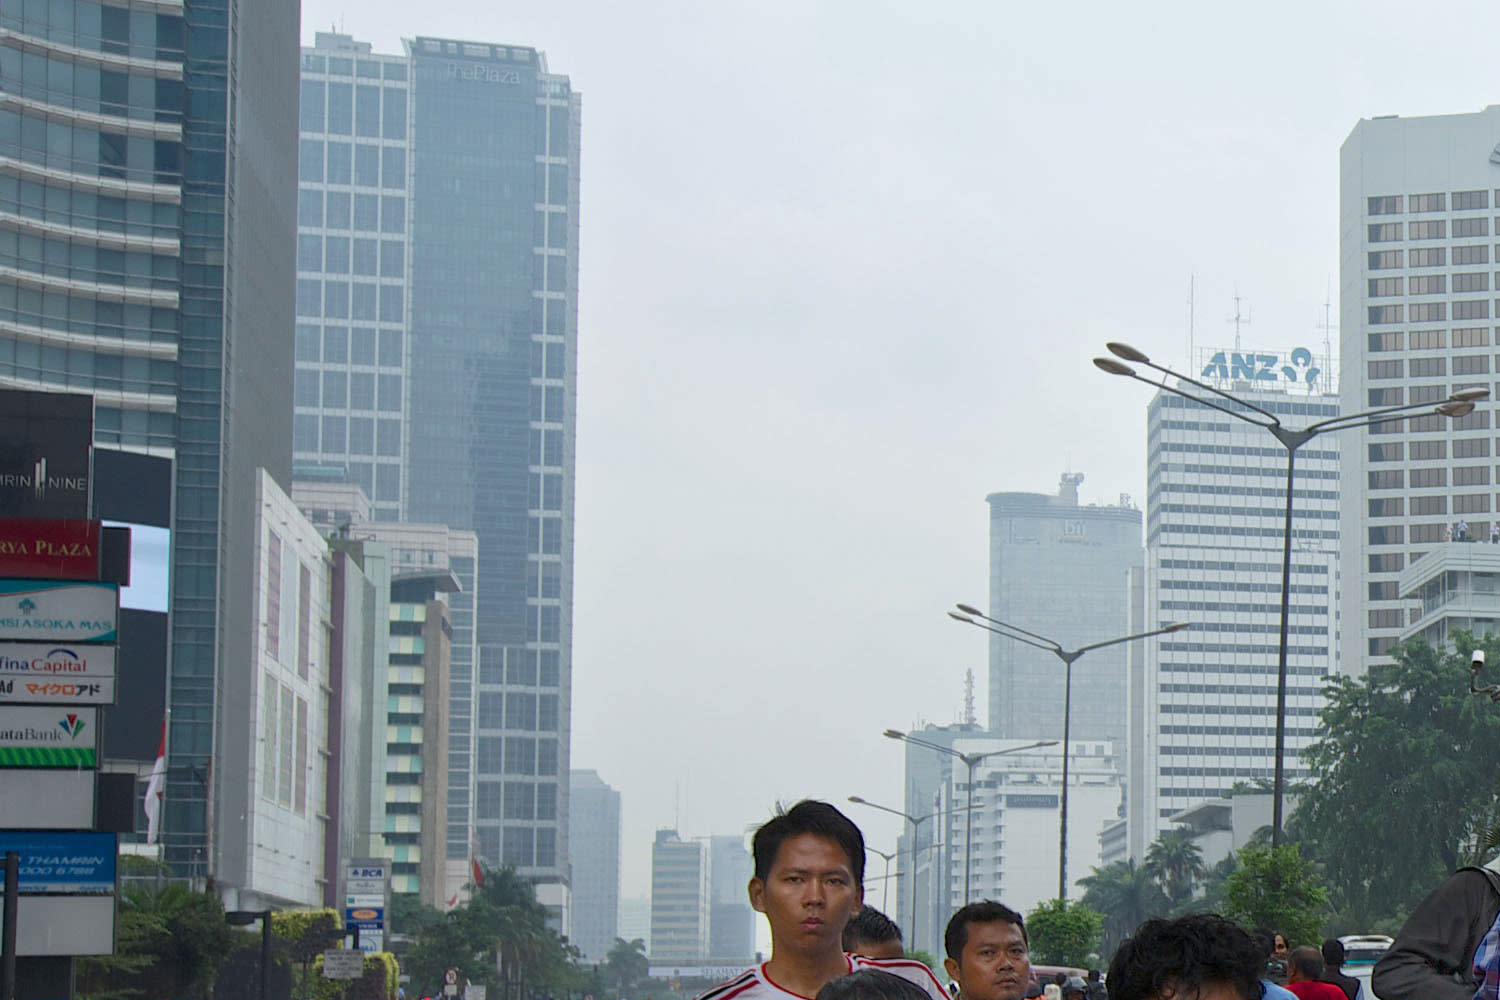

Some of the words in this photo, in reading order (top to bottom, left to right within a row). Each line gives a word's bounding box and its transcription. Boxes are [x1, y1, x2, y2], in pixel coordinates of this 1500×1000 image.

[1201, 352, 1278, 380] ANZ
[48, 477, 87, 490] NINE
[22, 619, 75, 630] ASOKA
[79, 621, 112, 630] MAS
[361, 869, 383, 877] BCA
